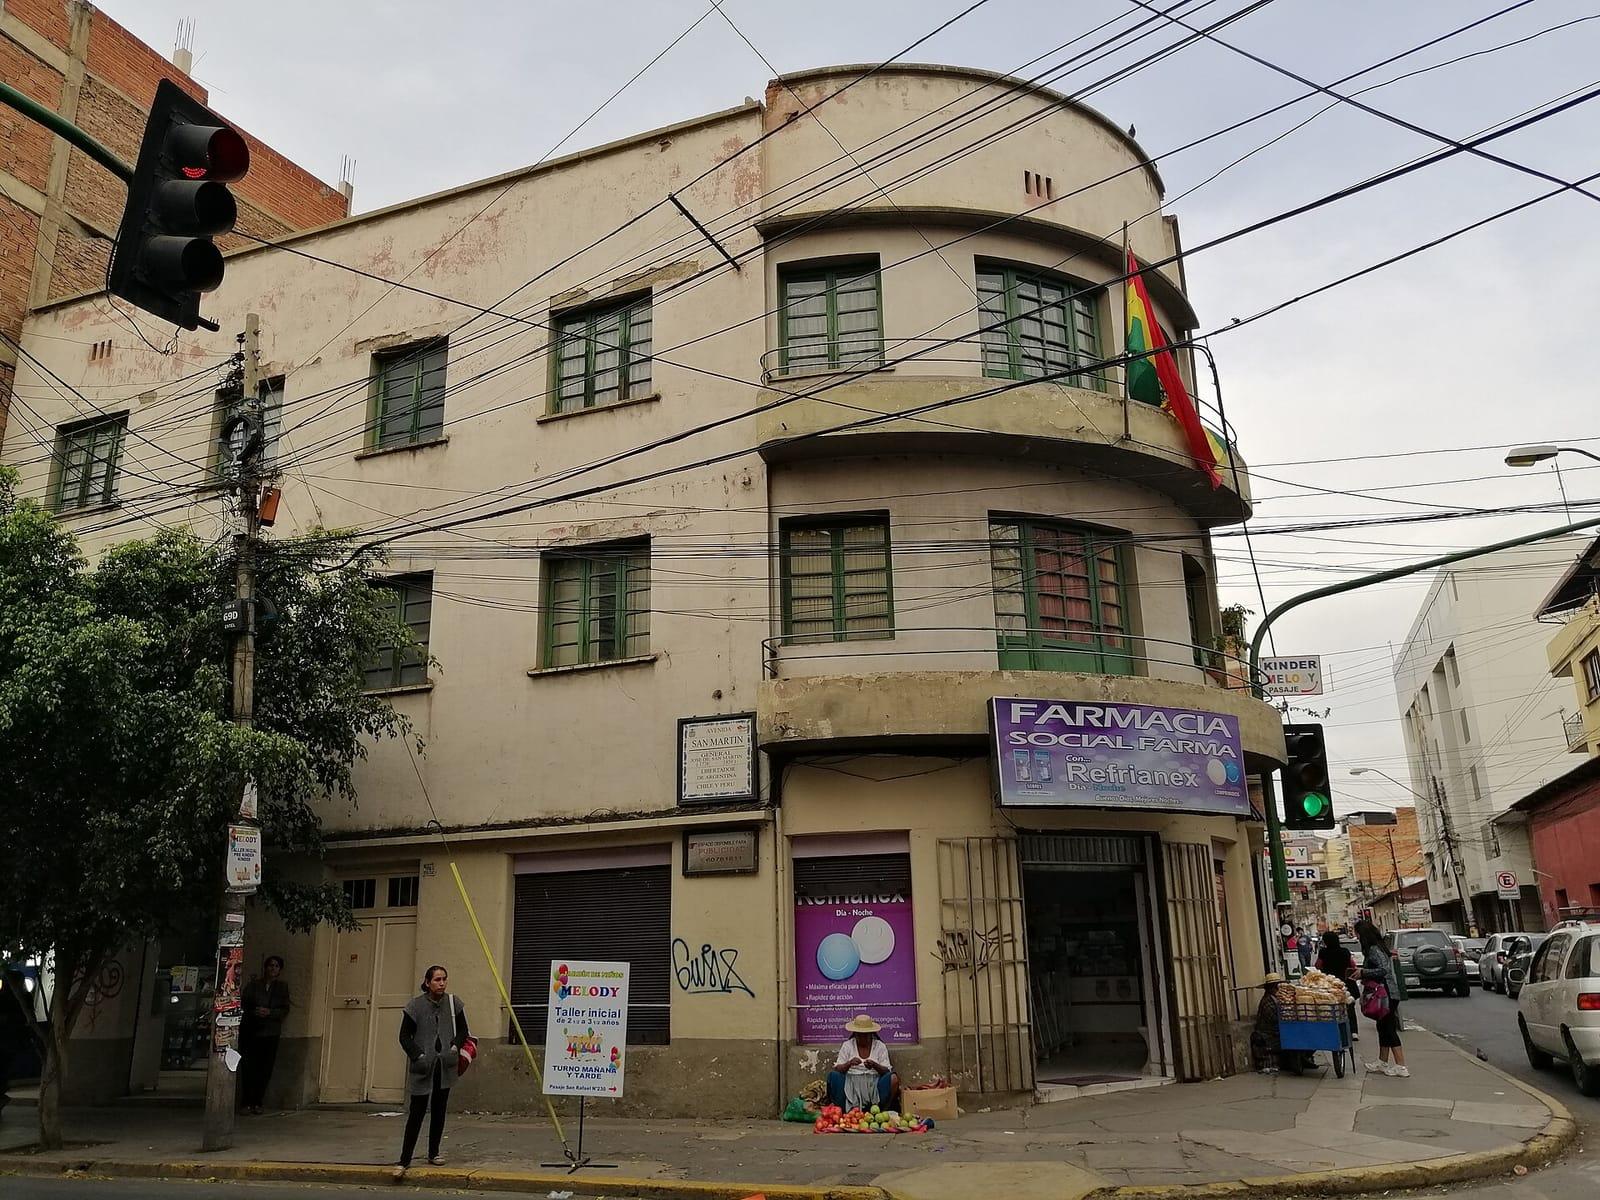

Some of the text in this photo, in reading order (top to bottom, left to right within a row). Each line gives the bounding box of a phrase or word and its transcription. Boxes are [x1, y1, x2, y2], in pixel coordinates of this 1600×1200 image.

[223, 611, 238, 621] 69D
[1264, 660, 1317, 670] KINDER
[1268, 673, 1315, 684] MELOY
[1010, 703, 1232, 738] FARMACIA
[692, 736, 743, 748] SAN MARTIN
[1009, 731, 1237, 758] SOCIAL FARMA
[1066, 763, 1199, 788] Refrianex
[561, 986, 620, 997] MELODY
[555, 1007, 621, 1018] Taller inicial
[601, 1018, 620, 1026] años
[581, 1066, 617, 1074] MAÑANA
